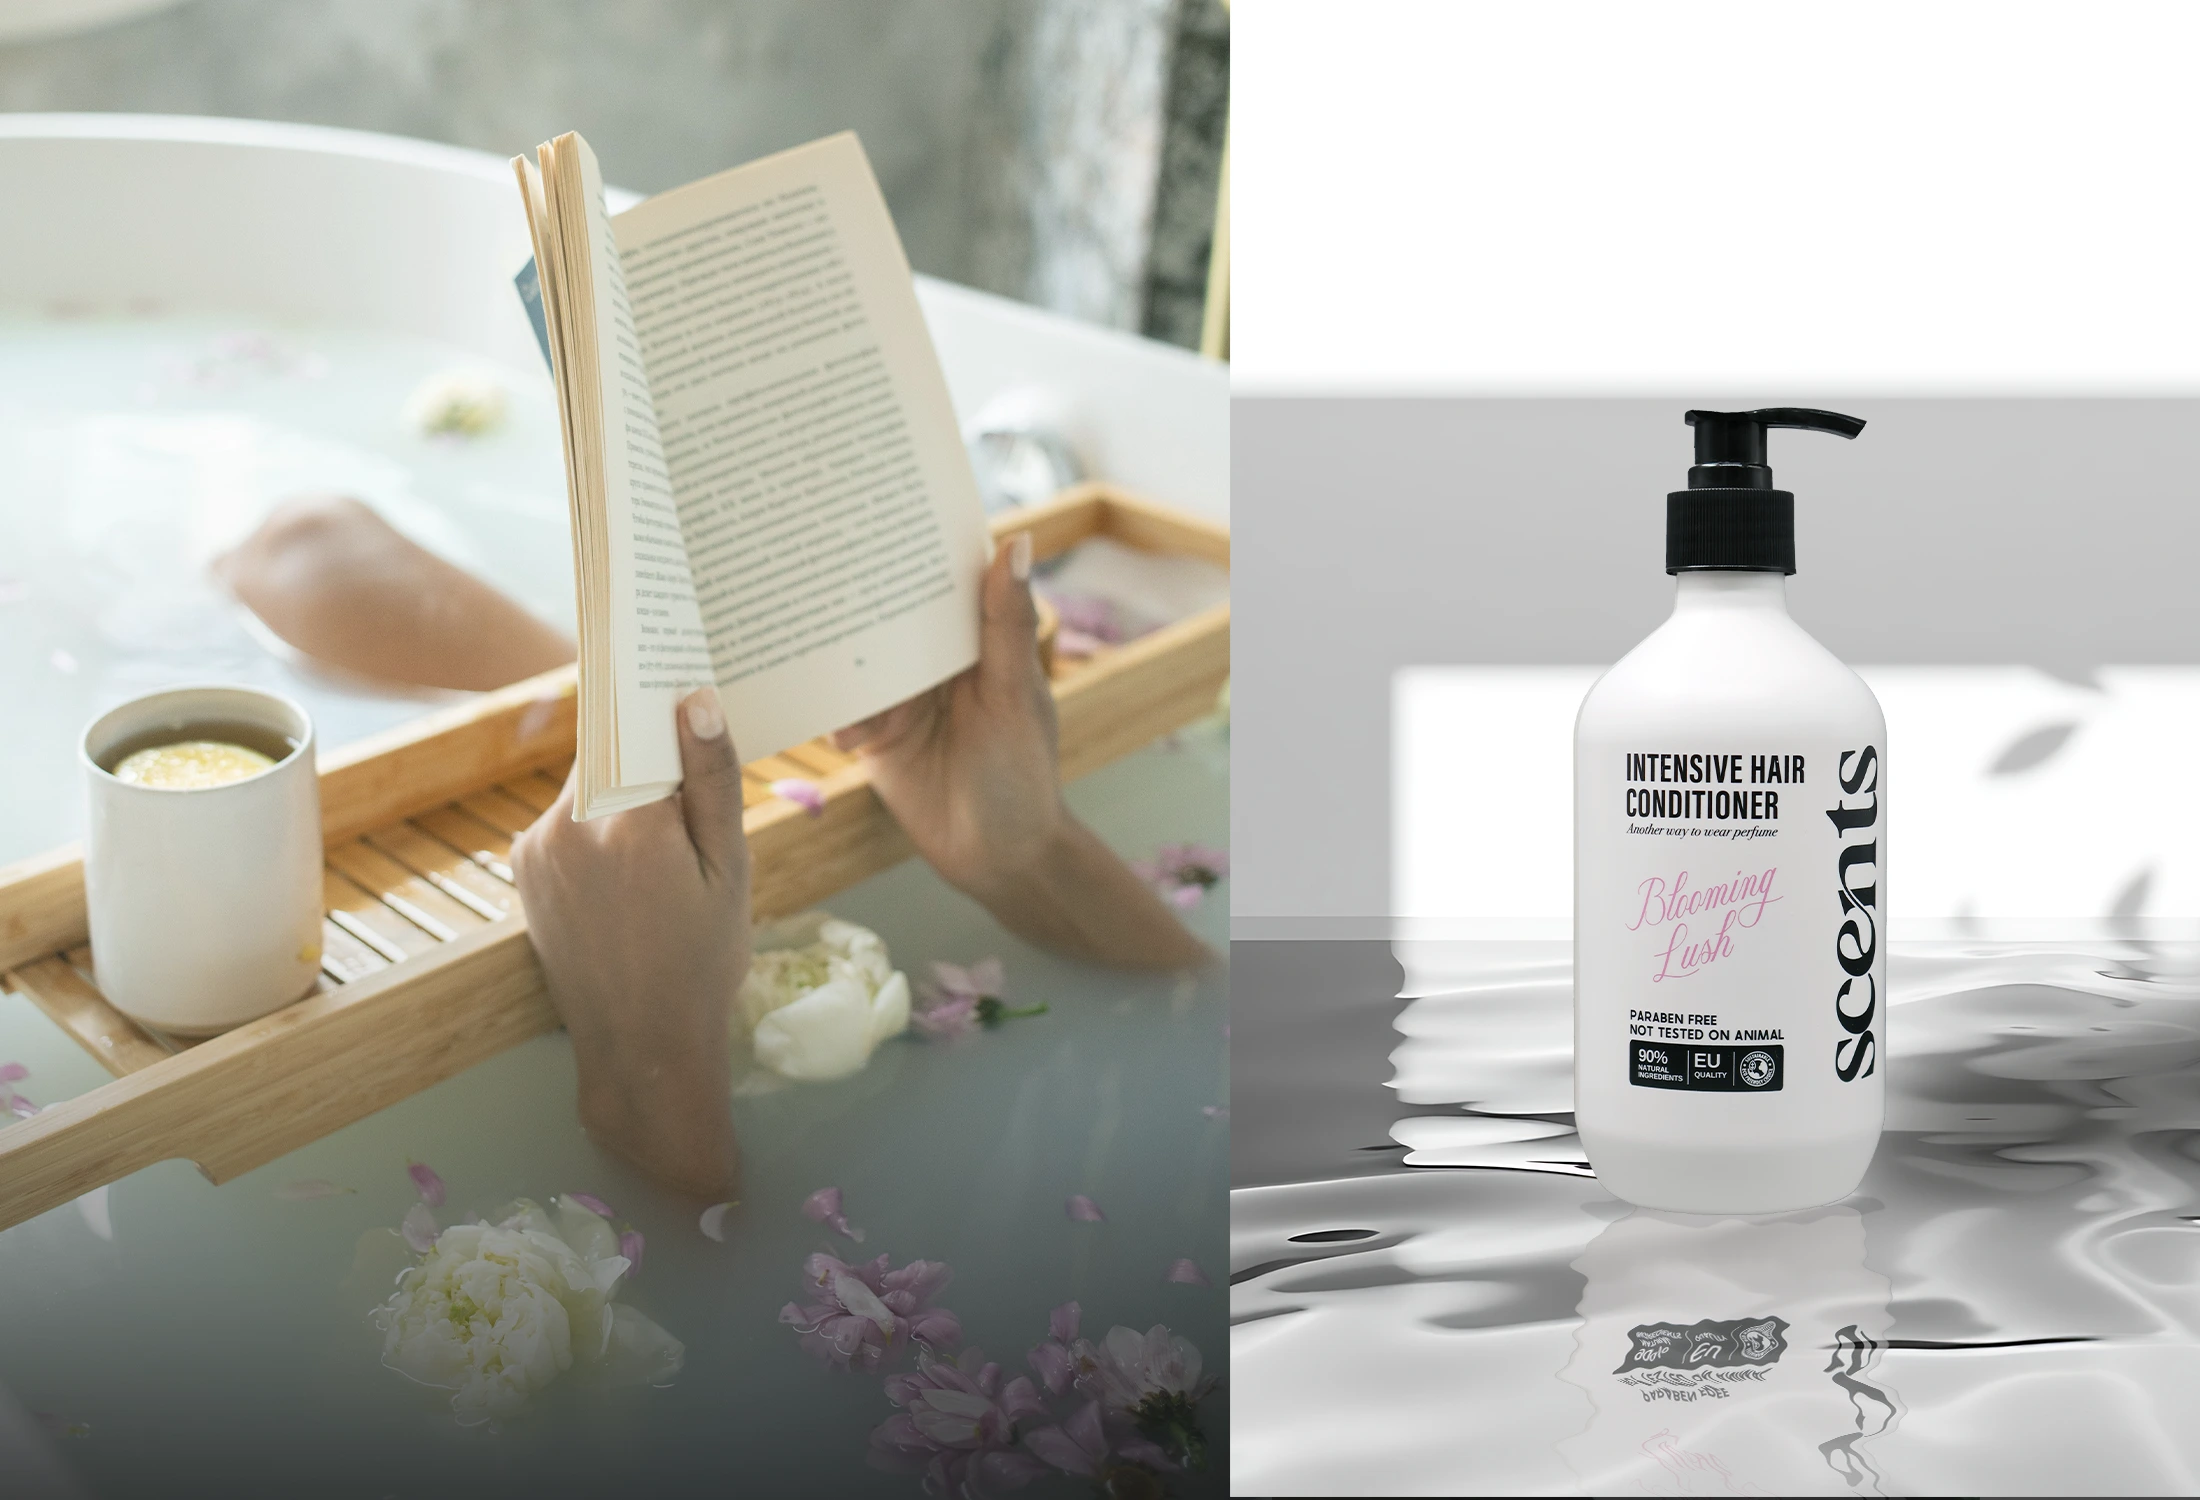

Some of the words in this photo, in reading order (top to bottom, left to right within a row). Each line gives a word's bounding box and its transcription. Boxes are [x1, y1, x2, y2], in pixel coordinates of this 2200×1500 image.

[1626, 753, 1743, 784] INTENSIVE
[1751, 754, 1805, 784] HAIR
[1626, 788, 1779, 820] CONDITIONER
[1626, 823, 1664, 836] Another
[1666, 826, 1689, 840] way
[1690, 825, 1702, 838] to
[1704, 828, 1732, 838] wear
[1732, 825, 1779, 841] perfume
[1625, 867, 1784, 931] Blooming
[1825, 744, 1879, 1083] scents
[1653, 909, 1735, 983] Lush
[1630, 1009, 1684, 1025] PARABEN
[1688, 1014, 1718, 1026] FREE
[1630, 1024, 1654, 1037] NOT
[1658, 1027, 1704, 1040] TESTED
[1708, 1029, 1730, 1041] ON
[1734, 1029, 1785, 1041] ANIMAL
[1638, 1048, 1669, 1065] 90%
[1694, 1053, 1721, 1068] EU
[1638, 1064, 1670, 1074] NATURAL
[1638, 1072, 1684, 1082] INGREDIENTS
[1694, 1071, 1728, 1080] QUALITY
